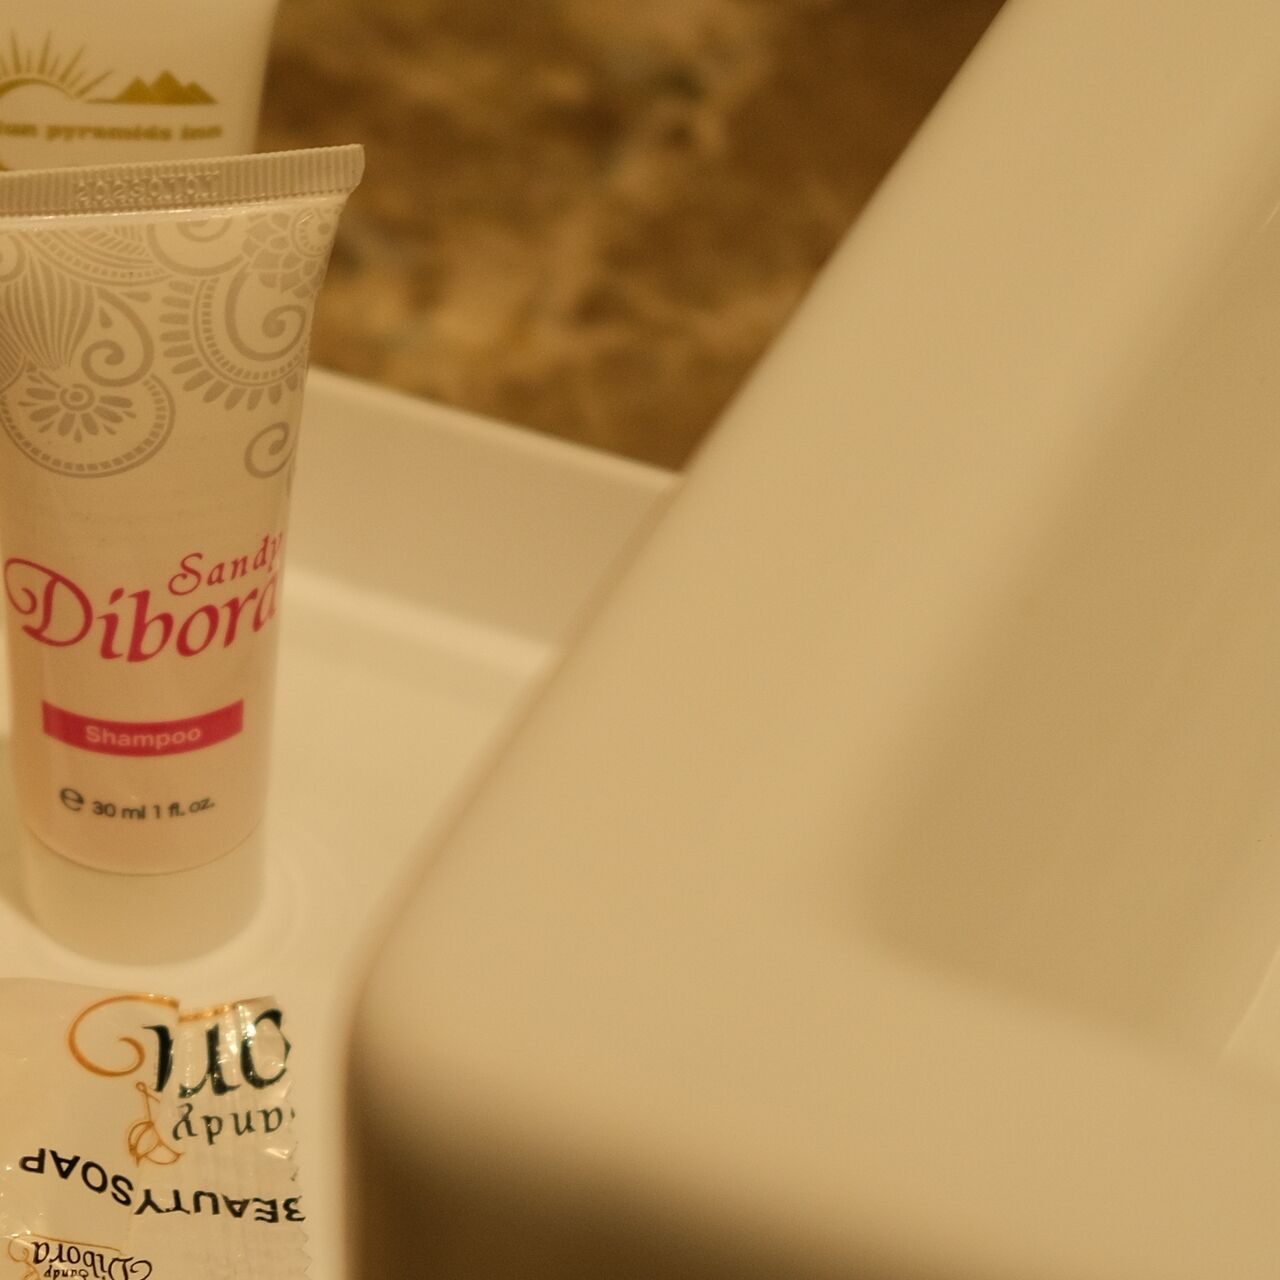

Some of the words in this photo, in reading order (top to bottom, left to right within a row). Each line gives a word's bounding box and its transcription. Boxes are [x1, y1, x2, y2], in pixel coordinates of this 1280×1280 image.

[167, 531, 284, 596] Sandy
[3, 557, 280, 663] Dibora
[84, 724, 201, 750] Shampoo
[92, 800, 116, 818] 30
[121, 805, 146, 820] ml
[153, 804, 161, 818] 1
[189, 797, 216, 814] oz.
[171, 1102, 296, 1146] andy
